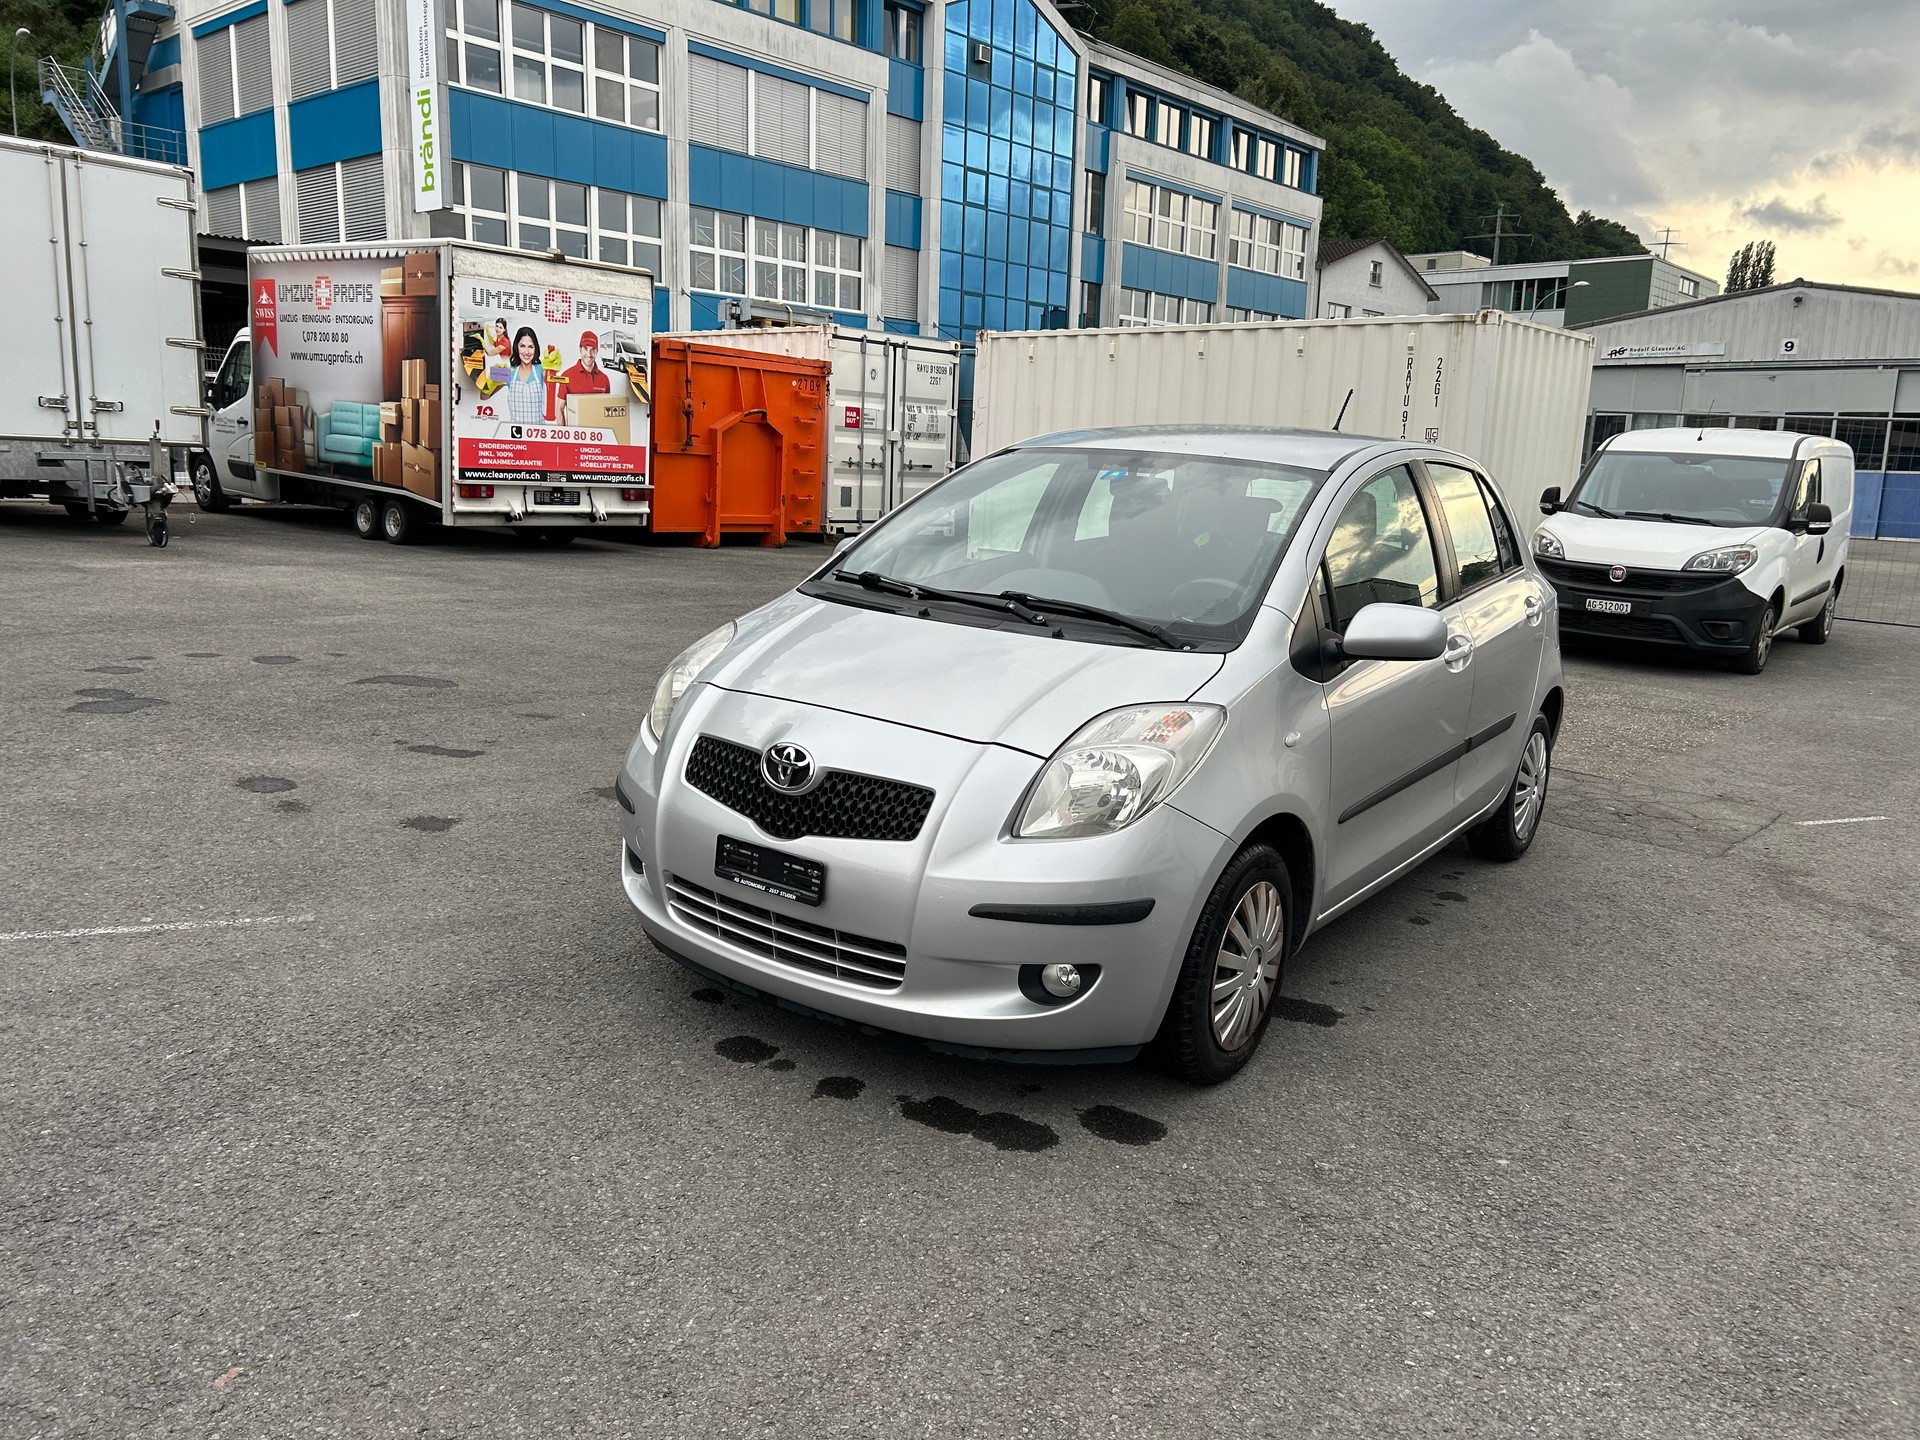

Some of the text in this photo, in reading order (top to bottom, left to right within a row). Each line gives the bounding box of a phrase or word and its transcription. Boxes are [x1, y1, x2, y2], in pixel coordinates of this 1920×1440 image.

[417, 88, 436, 193] brändi
[278, 284, 373, 303] UMZUG PROFIS
[471, 287, 638, 325] UMZUG PROFIS
[255, 307, 275, 319] SWISS
[279, 314, 374, 325] UMZUG REINIGUNG ENTSORGUNG
[306, 331, 349, 343] 078 200 80 80
[1783, 340, 1795, 352] 9
[290, 350, 364, 366] www.umzugprofis.ch
[917, 364, 929, 373] RAYU
[1403, 357, 1414, 407] RAYU
[1434, 357, 1443, 408] 22G1
[526, 428, 603, 442] 078 200 80 80
[478, 442, 527, 451] ENDREINIGUNG
[478, 458, 543, 467] ABNAHMEGARANTIE
[580, 454, 620, 462] ENTSORGUNG
[580, 460, 612, 469] MÖBELLIFT
[464, 471, 541, 480] www.cleanprofis.ch
[571, 473, 644, 483] www.umzugprofis.ch
[1587, 600, 1597, 608] AG
[740, 879, 766, 890] AUTOMOBILE
